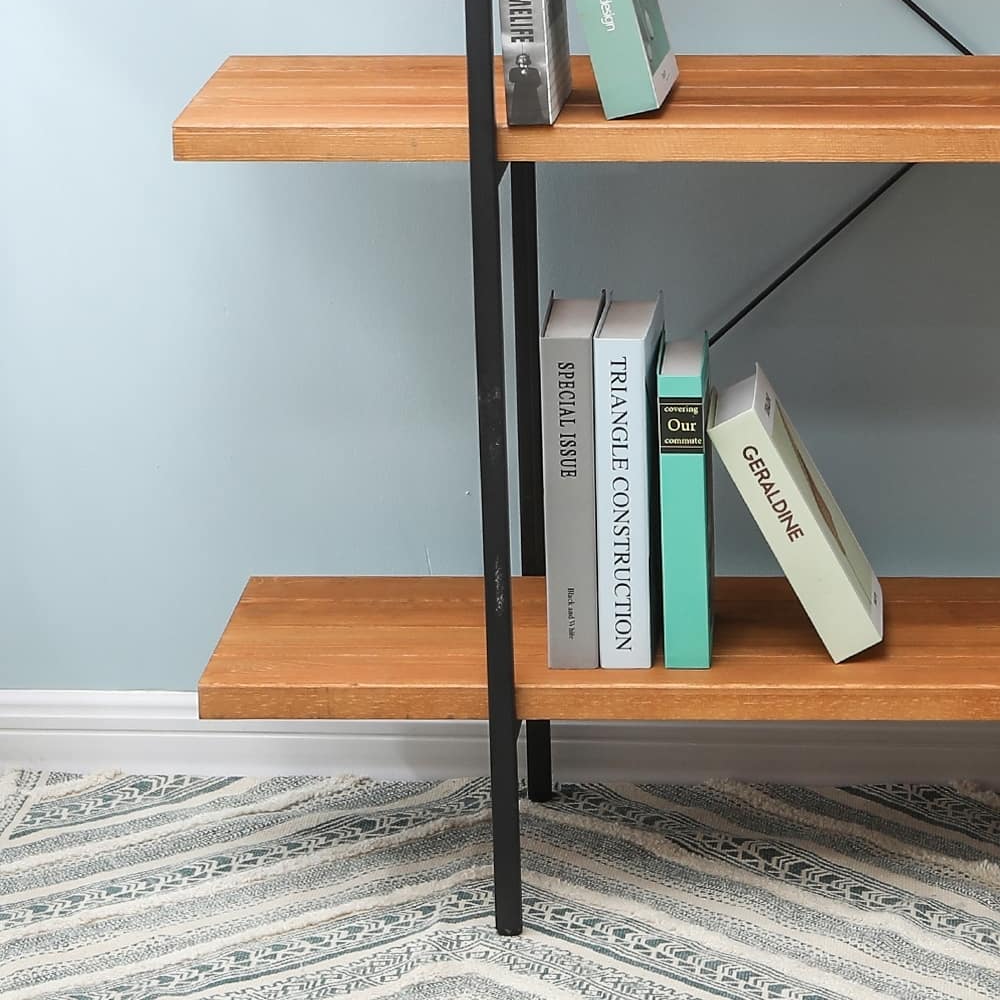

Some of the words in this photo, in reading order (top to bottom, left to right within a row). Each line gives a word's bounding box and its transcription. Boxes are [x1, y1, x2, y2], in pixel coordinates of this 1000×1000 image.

[557, 362, 576, 428] SPECIAL
[610, 356, 629, 471] TRIANGLE
[664, 405, 699, 414] covering
[664, 437, 702, 445] commute
[667, 417, 697, 433] Our
[559, 433, 577, 478] ISSUE
[742, 445, 805, 543] GERALDINE
[612, 477, 632, 651] CONSTRUCTION
